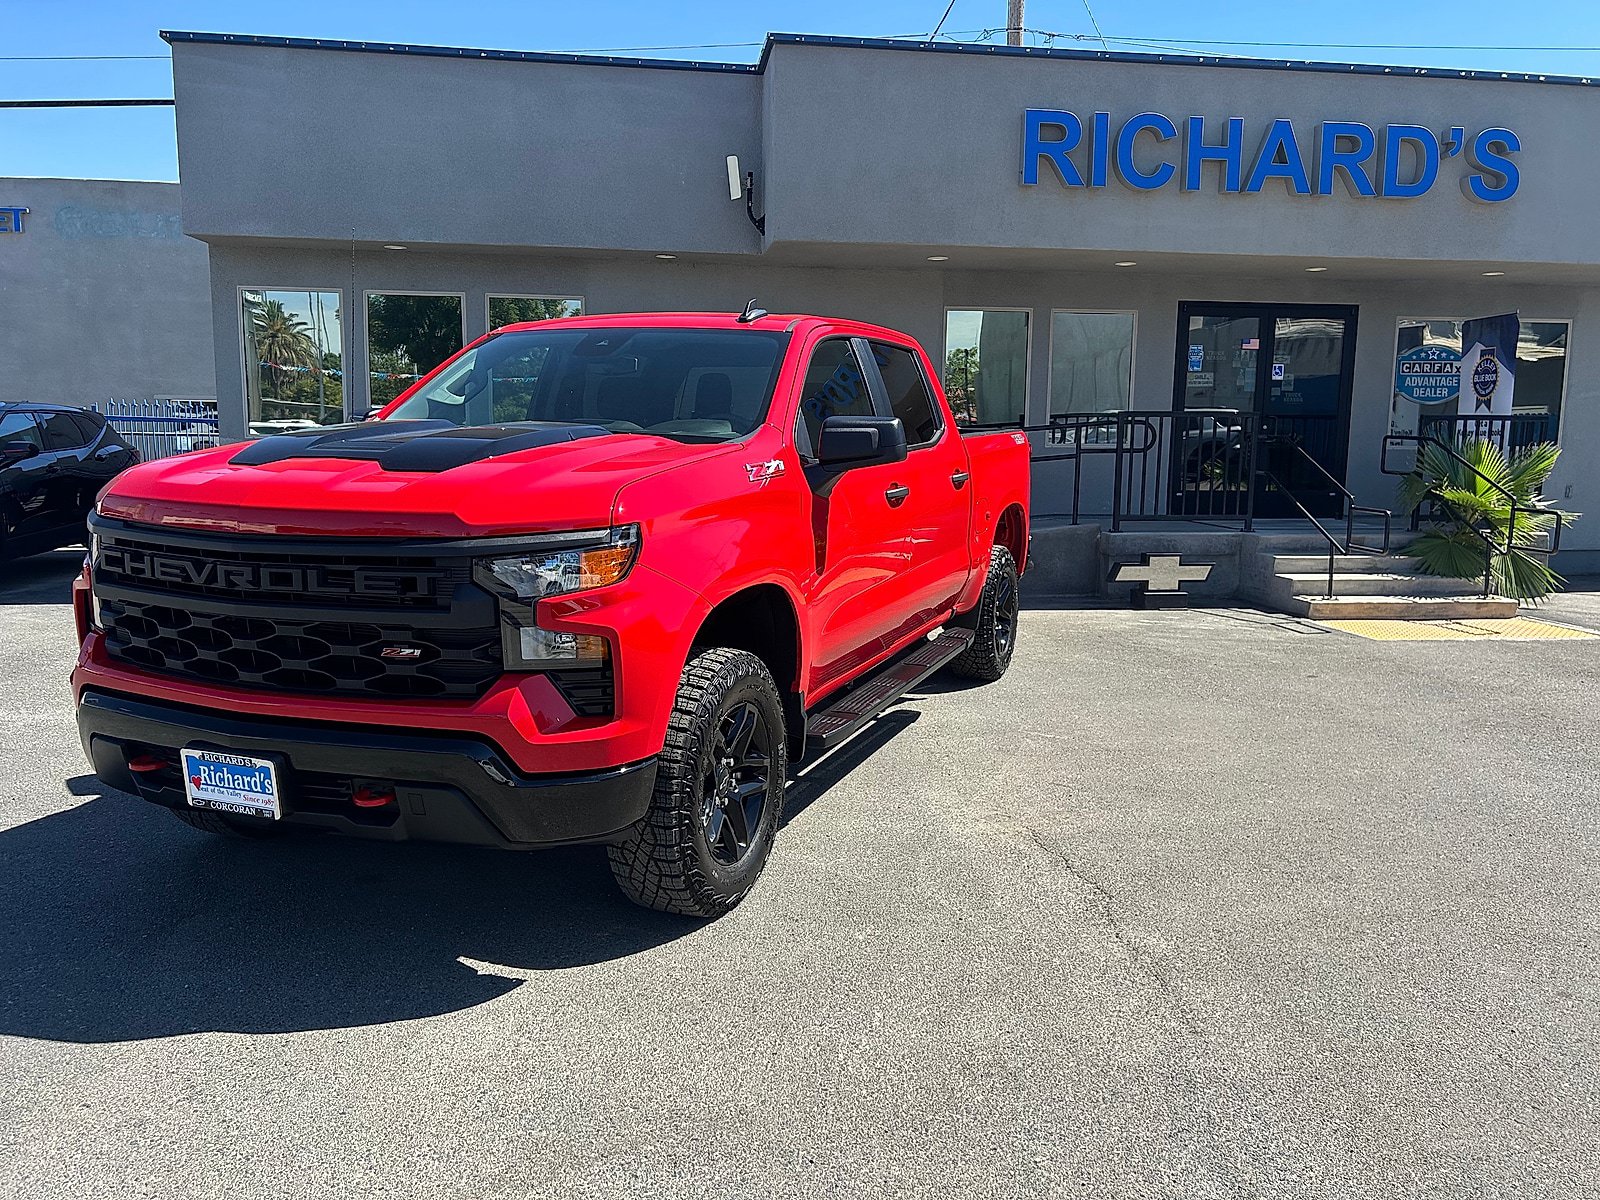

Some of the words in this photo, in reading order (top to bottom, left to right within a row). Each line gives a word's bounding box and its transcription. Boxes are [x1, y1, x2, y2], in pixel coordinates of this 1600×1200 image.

[1021, 107, 1522, 203] RICHARD'S
[1402, 362, 1462, 374] CARFAX
[1404, 376, 1459, 387] ADVANTAGE
[1413, 387, 1448, 398] DEALER
[99, 549, 445, 595] CHEVROLET
[381, 647, 421, 658] Z71
[199, 765, 273, 795] Richard's
[225, 789, 241, 799] Valley
[243, 794, 260, 804] Since
[261, 798, 275, 808] 1987
[210, 801, 257, 816] CORCORAN
